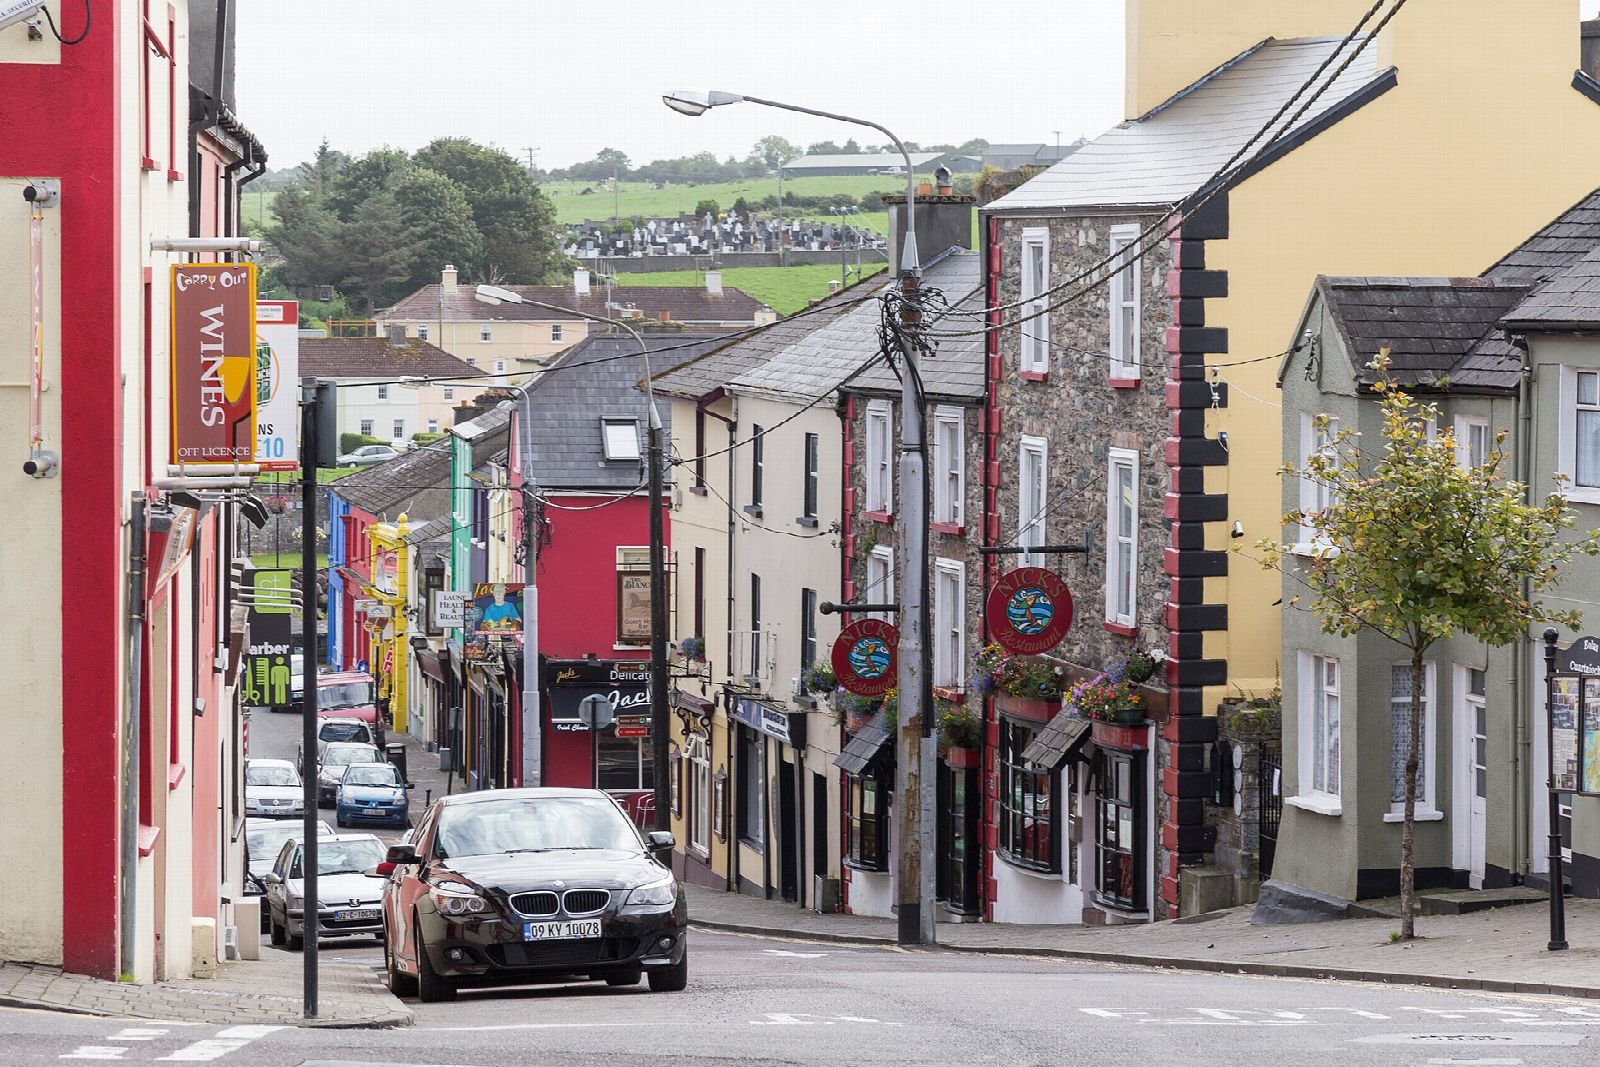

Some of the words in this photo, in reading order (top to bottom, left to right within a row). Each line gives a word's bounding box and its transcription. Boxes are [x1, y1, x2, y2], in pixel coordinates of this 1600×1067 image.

[200, 303, 226, 427] WINES
[258, 424, 274, 435] NS
[178, 447, 199, 456] OFF
[202, 446, 250, 456] LICENCE
[624, 580, 650, 589] BIANC
[249, 641, 290, 655] arber
[531, 925, 545, 938] 09
[548, 923, 562, 937] KY
[565, 922, 600, 936] 10078
